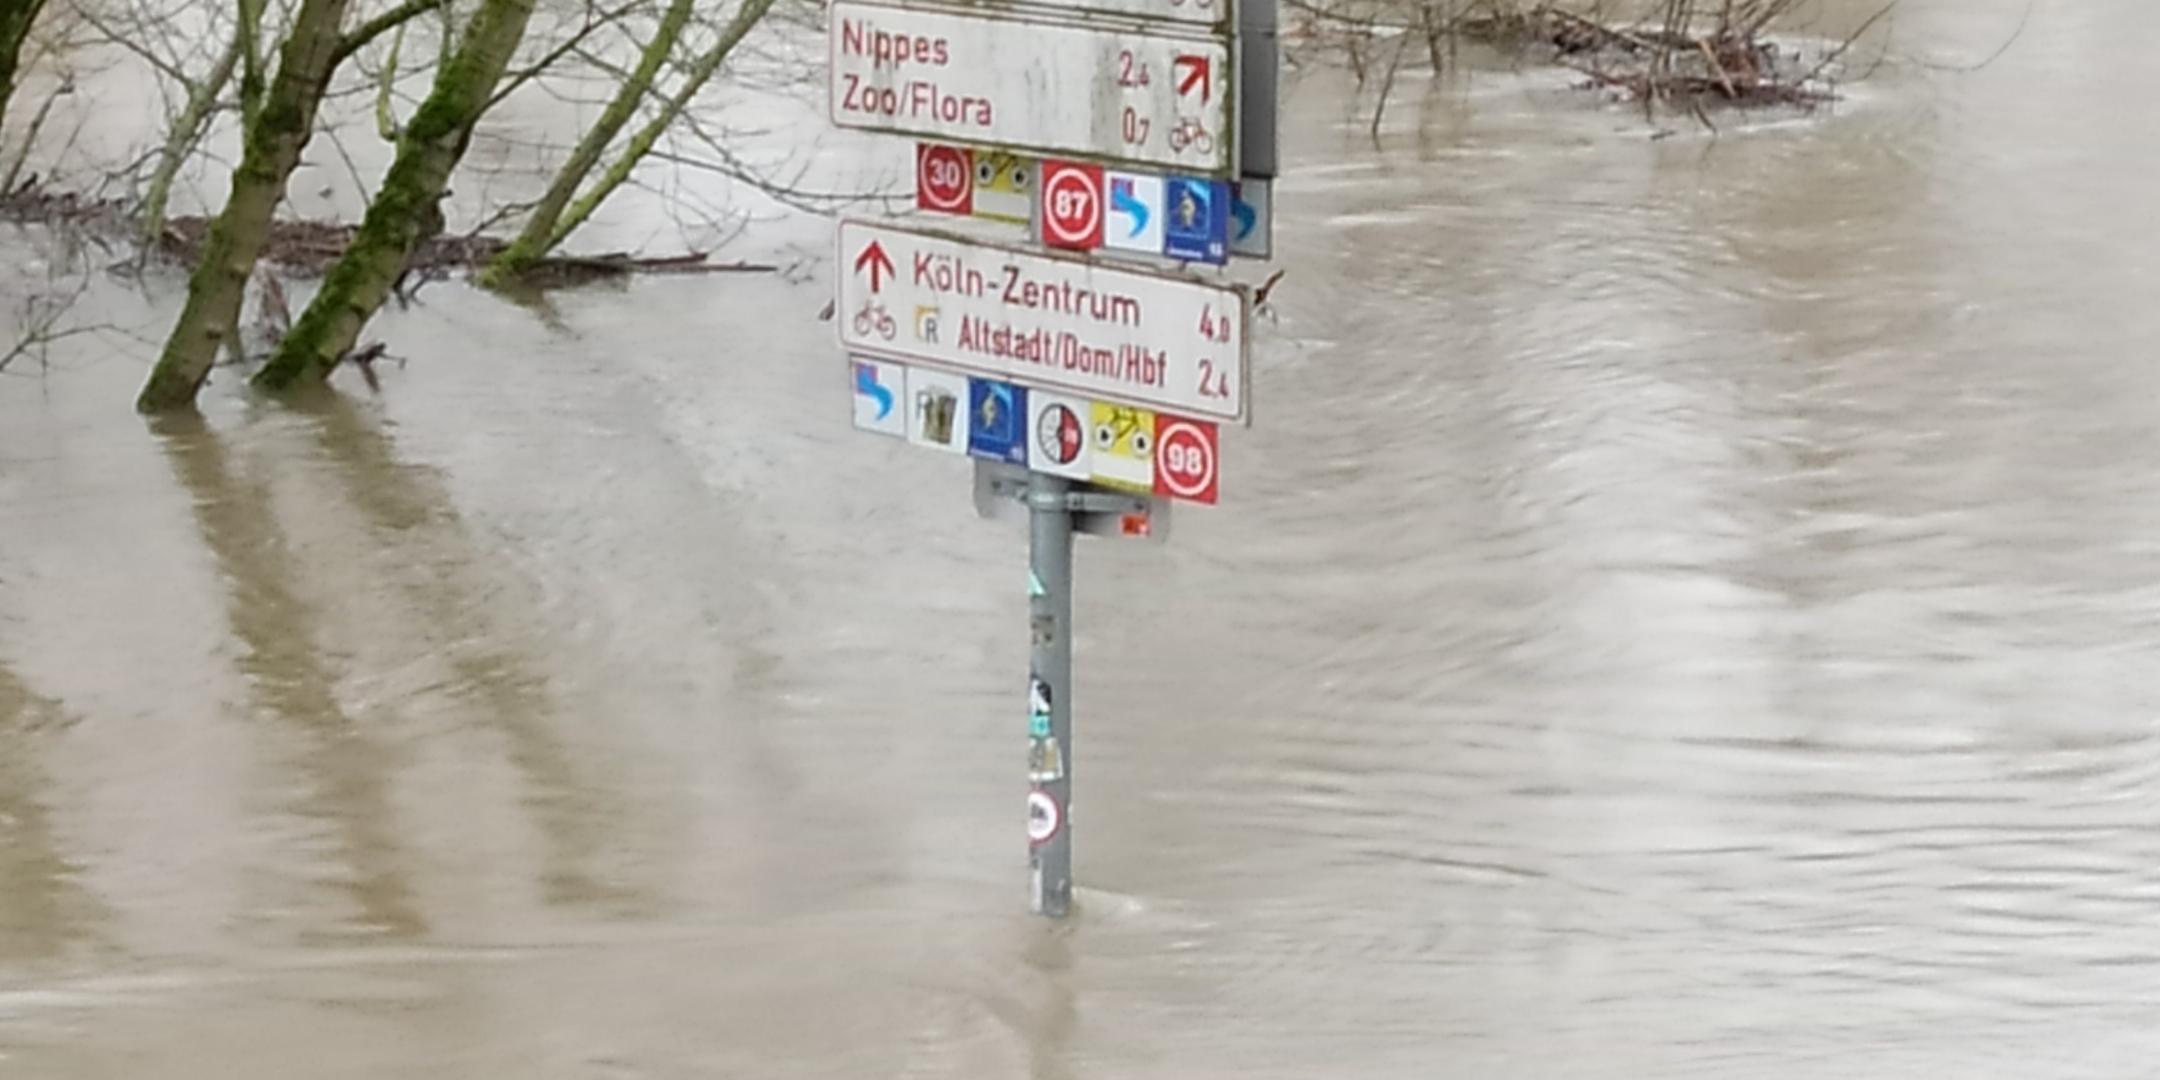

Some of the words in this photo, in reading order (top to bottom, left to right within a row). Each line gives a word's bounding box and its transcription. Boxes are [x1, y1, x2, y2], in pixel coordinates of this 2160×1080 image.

[842, 17, 949, 69] Nippes
[842, 73, 992, 126] Zoo/Flora
[929, 157, 961, 189] 30
[1055, 188, 1089, 220] 87
[913, 250, 1140, 327] Köln-Zentrum
[957, 313, 1167, 388] Altstadt/Dom/Hbf
[1167, 442, 1203, 476] 98
